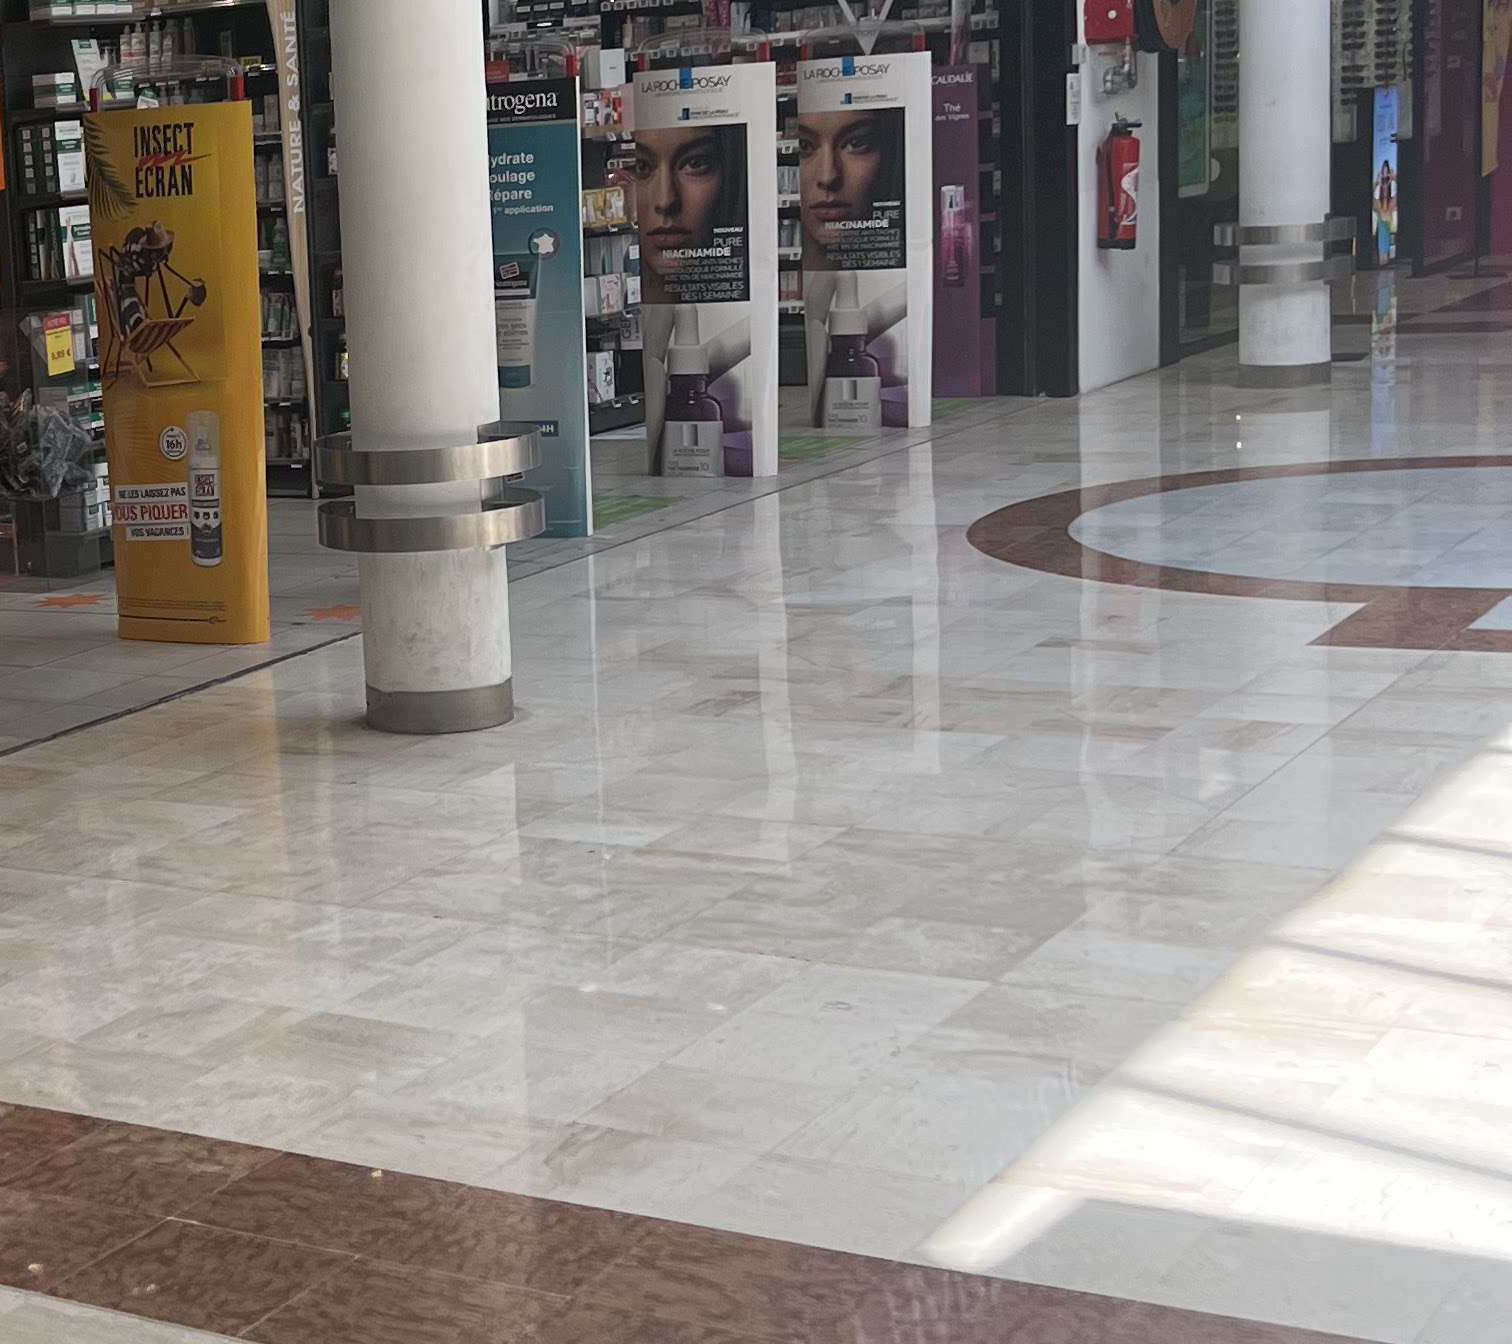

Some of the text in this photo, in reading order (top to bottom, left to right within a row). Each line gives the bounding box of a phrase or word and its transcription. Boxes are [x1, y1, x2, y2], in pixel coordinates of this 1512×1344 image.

[487, 91, 558, 115] trogena
[279, 10, 306, 214] NATURE & SANTÉ
[134, 122, 194, 159] INSECT
[488, 152, 534, 168] ydrate
[135, 164, 194, 199] ECRAN
[489, 171, 536, 184] oulage
[504, 204, 554, 216] application
[713, 236, 744, 247] PURE
[662, 246, 732, 259] NIACINAMIDE
[165, 439, 183, 450] 16h
[170, 486, 186, 497] PAS
[140, 503, 188, 521] PIQUER
[146, 526, 185, 537] VACANCES
